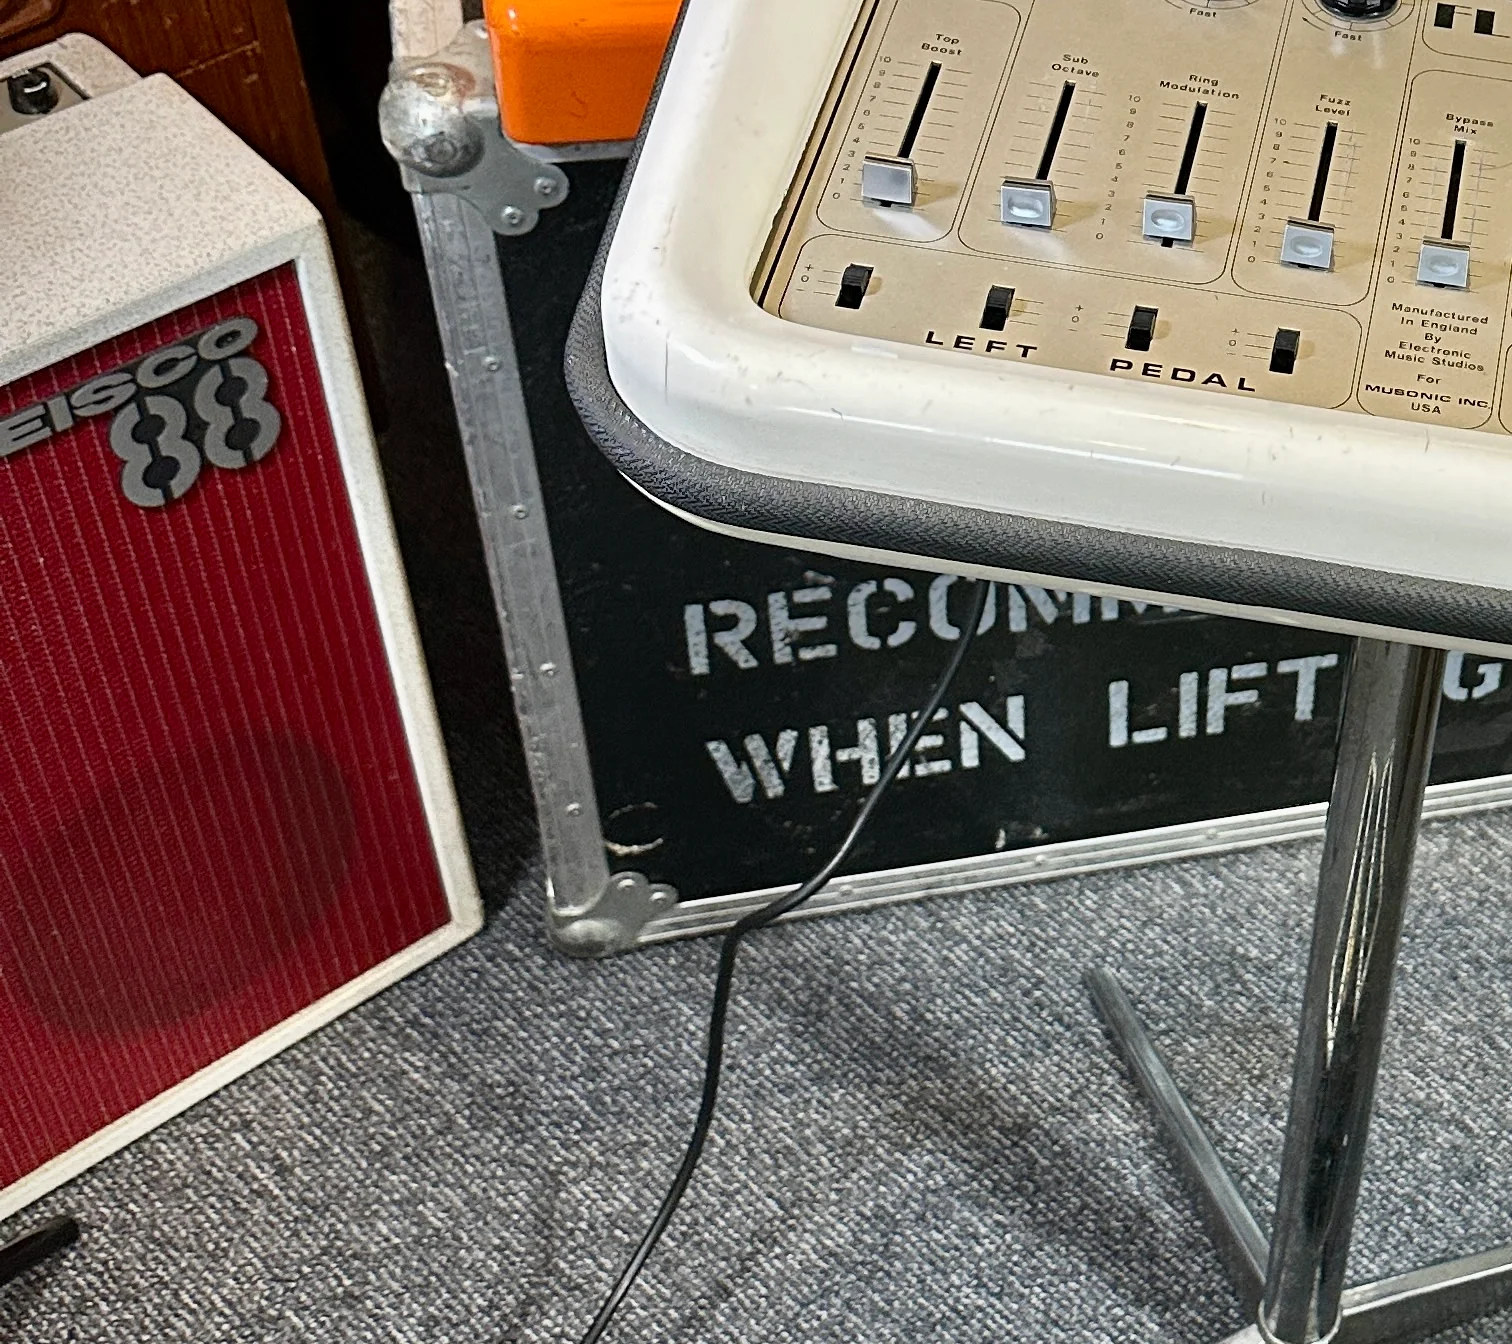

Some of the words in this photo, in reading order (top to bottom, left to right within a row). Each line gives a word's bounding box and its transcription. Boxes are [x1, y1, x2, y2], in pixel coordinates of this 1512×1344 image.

[1189, 7, 1217, 19] Fast
[935, 33, 960, 45] Top
[1334, 30, 1362, 42] Fast
[921, 42, 963, 56] Boost
[1063, 54, 1089, 65] Sub
[1051, 62, 1100, 78] Octave
[1189, 74, 1219, 87] Ring
[1159, 80, 1240, 100] Modulation
[1320, 94, 1351, 107] Fuzz
[1315, 104, 1351, 117] Level
[1446, 113, 1494, 128] Bypass
[1454, 124, 1478, 136] Mix
[1391, 302, 1489, 325] Manufactured
[1401, 317, 1414, 326] In
[1421, 319, 1478, 336] England
[1424, 333, 1442, 345] By
[1398, 341, 1472, 360] Electronic
[925, 330, 1038, 359] LEFT
[1110, 358, 1256, 392] PEDAL
[1384, 349, 1425, 364] Music
[1431, 356, 1484, 372] Studios
[1416, 374, 1442, 385] For
[1364, 384, 1451, 403] MUSONIC
[1411, 402, 1442, 415] USA
[109, 356, 282, 508] 88
[705, 694, 1027, 804] WHEN
[1107, 651, 1503, 748] LIFTG
